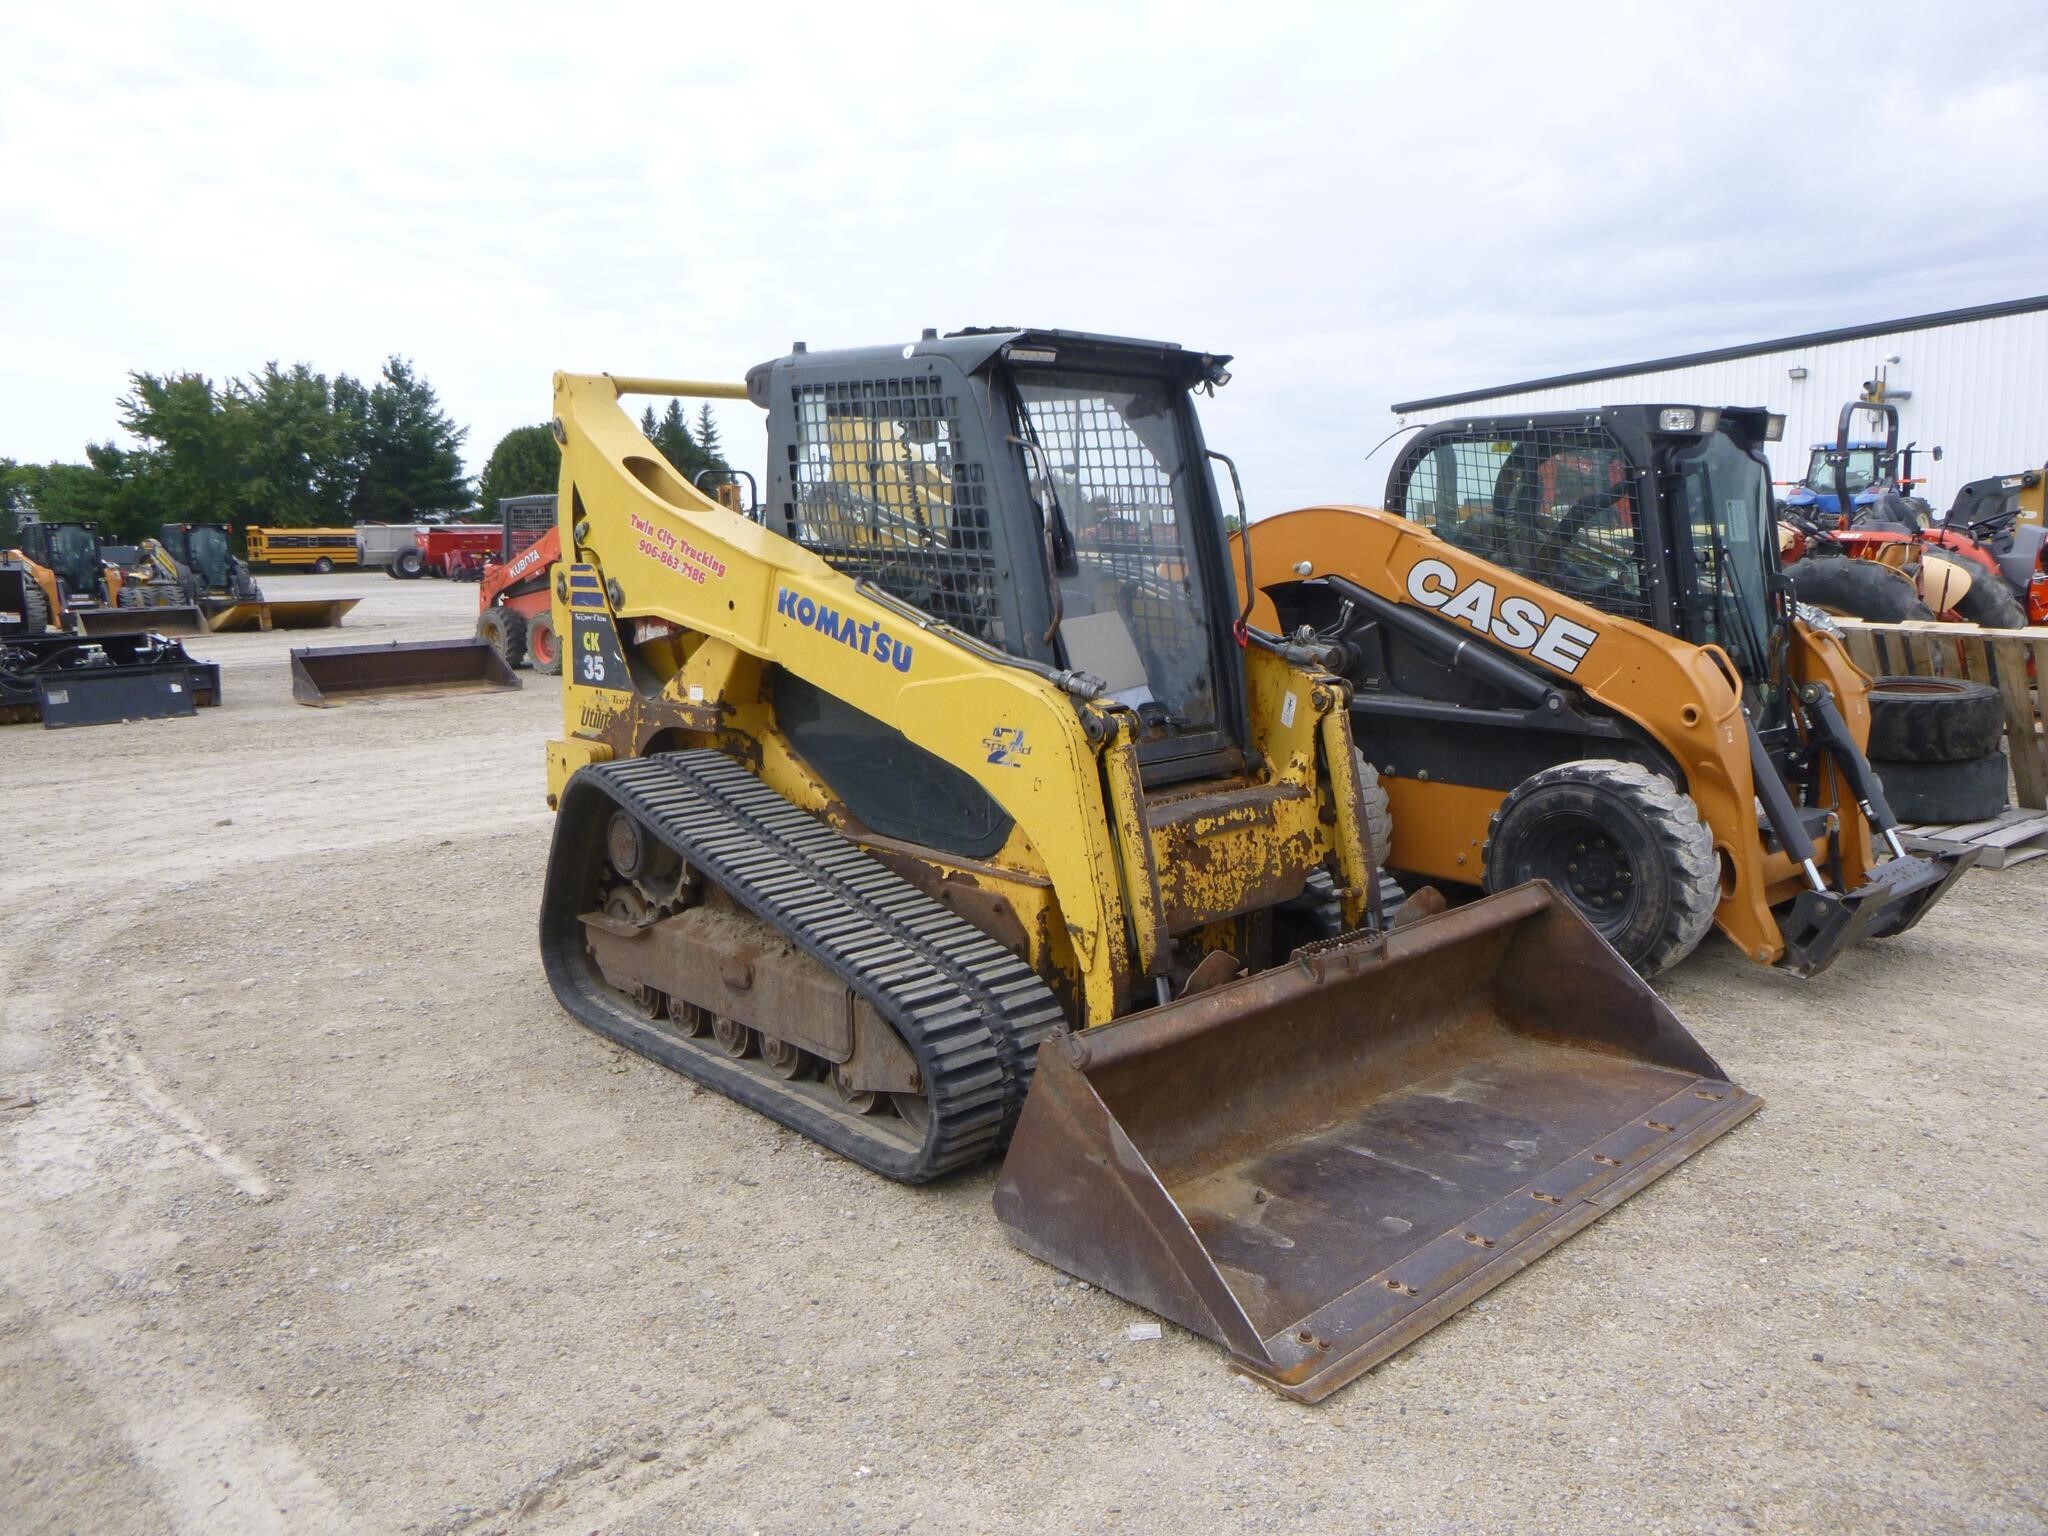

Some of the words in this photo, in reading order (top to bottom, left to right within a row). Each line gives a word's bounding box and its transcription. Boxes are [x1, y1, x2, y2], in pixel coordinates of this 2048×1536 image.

[510, 550, 540, 578] KUBOTA
[631, 513, 654, 537] Twin
[656, 528, 677, 550] City
[680, 540, 726, 578] Trucking
[777, 586, 913, 673] KOMATSU
[1407, 558, 1599, 675] CASE
[583, 632, 600, 651] CK
[583, 654, 605, 681] 35
